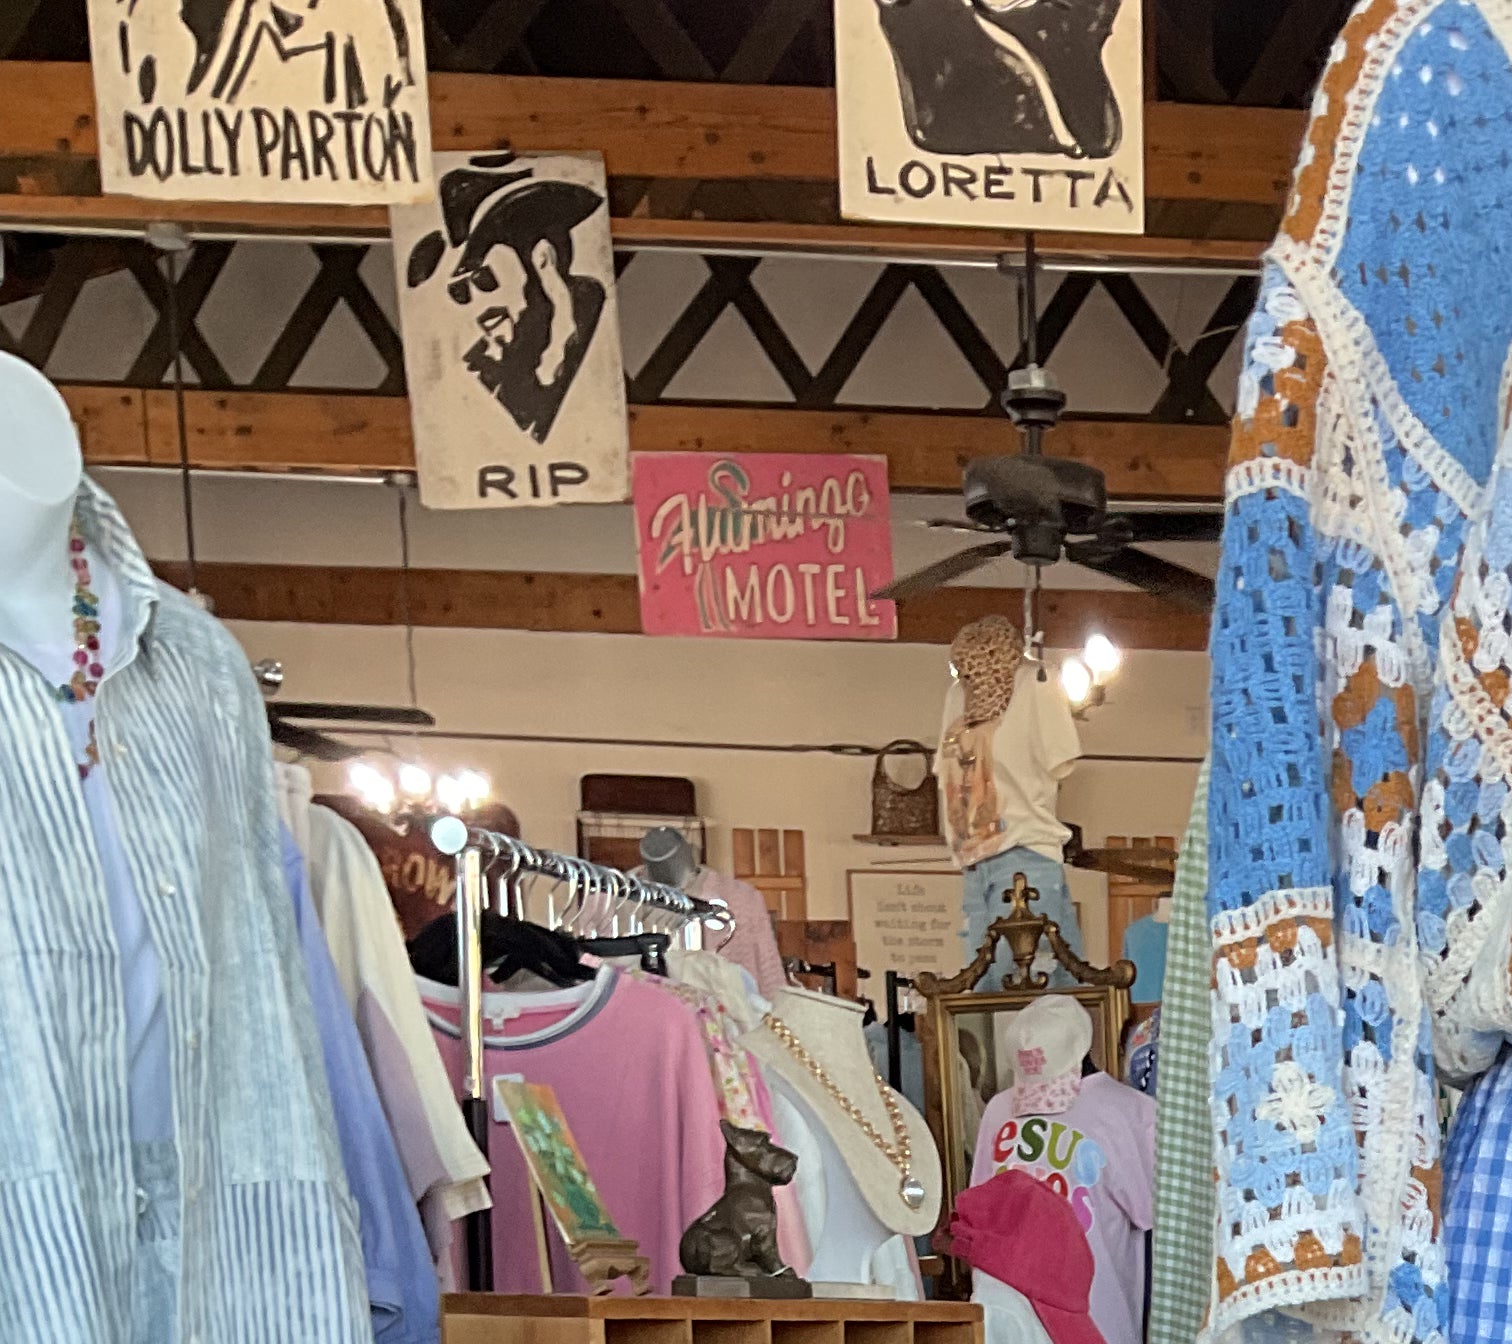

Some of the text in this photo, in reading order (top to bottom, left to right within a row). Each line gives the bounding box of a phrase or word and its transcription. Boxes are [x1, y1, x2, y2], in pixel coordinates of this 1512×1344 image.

[123, 105, 419, 183] DOLLY PARTON
[866, 156, 1134, 214] LORETTA
[478, 461, 590, 499] RIP
[725, 563, 881, 627] MOTEL
